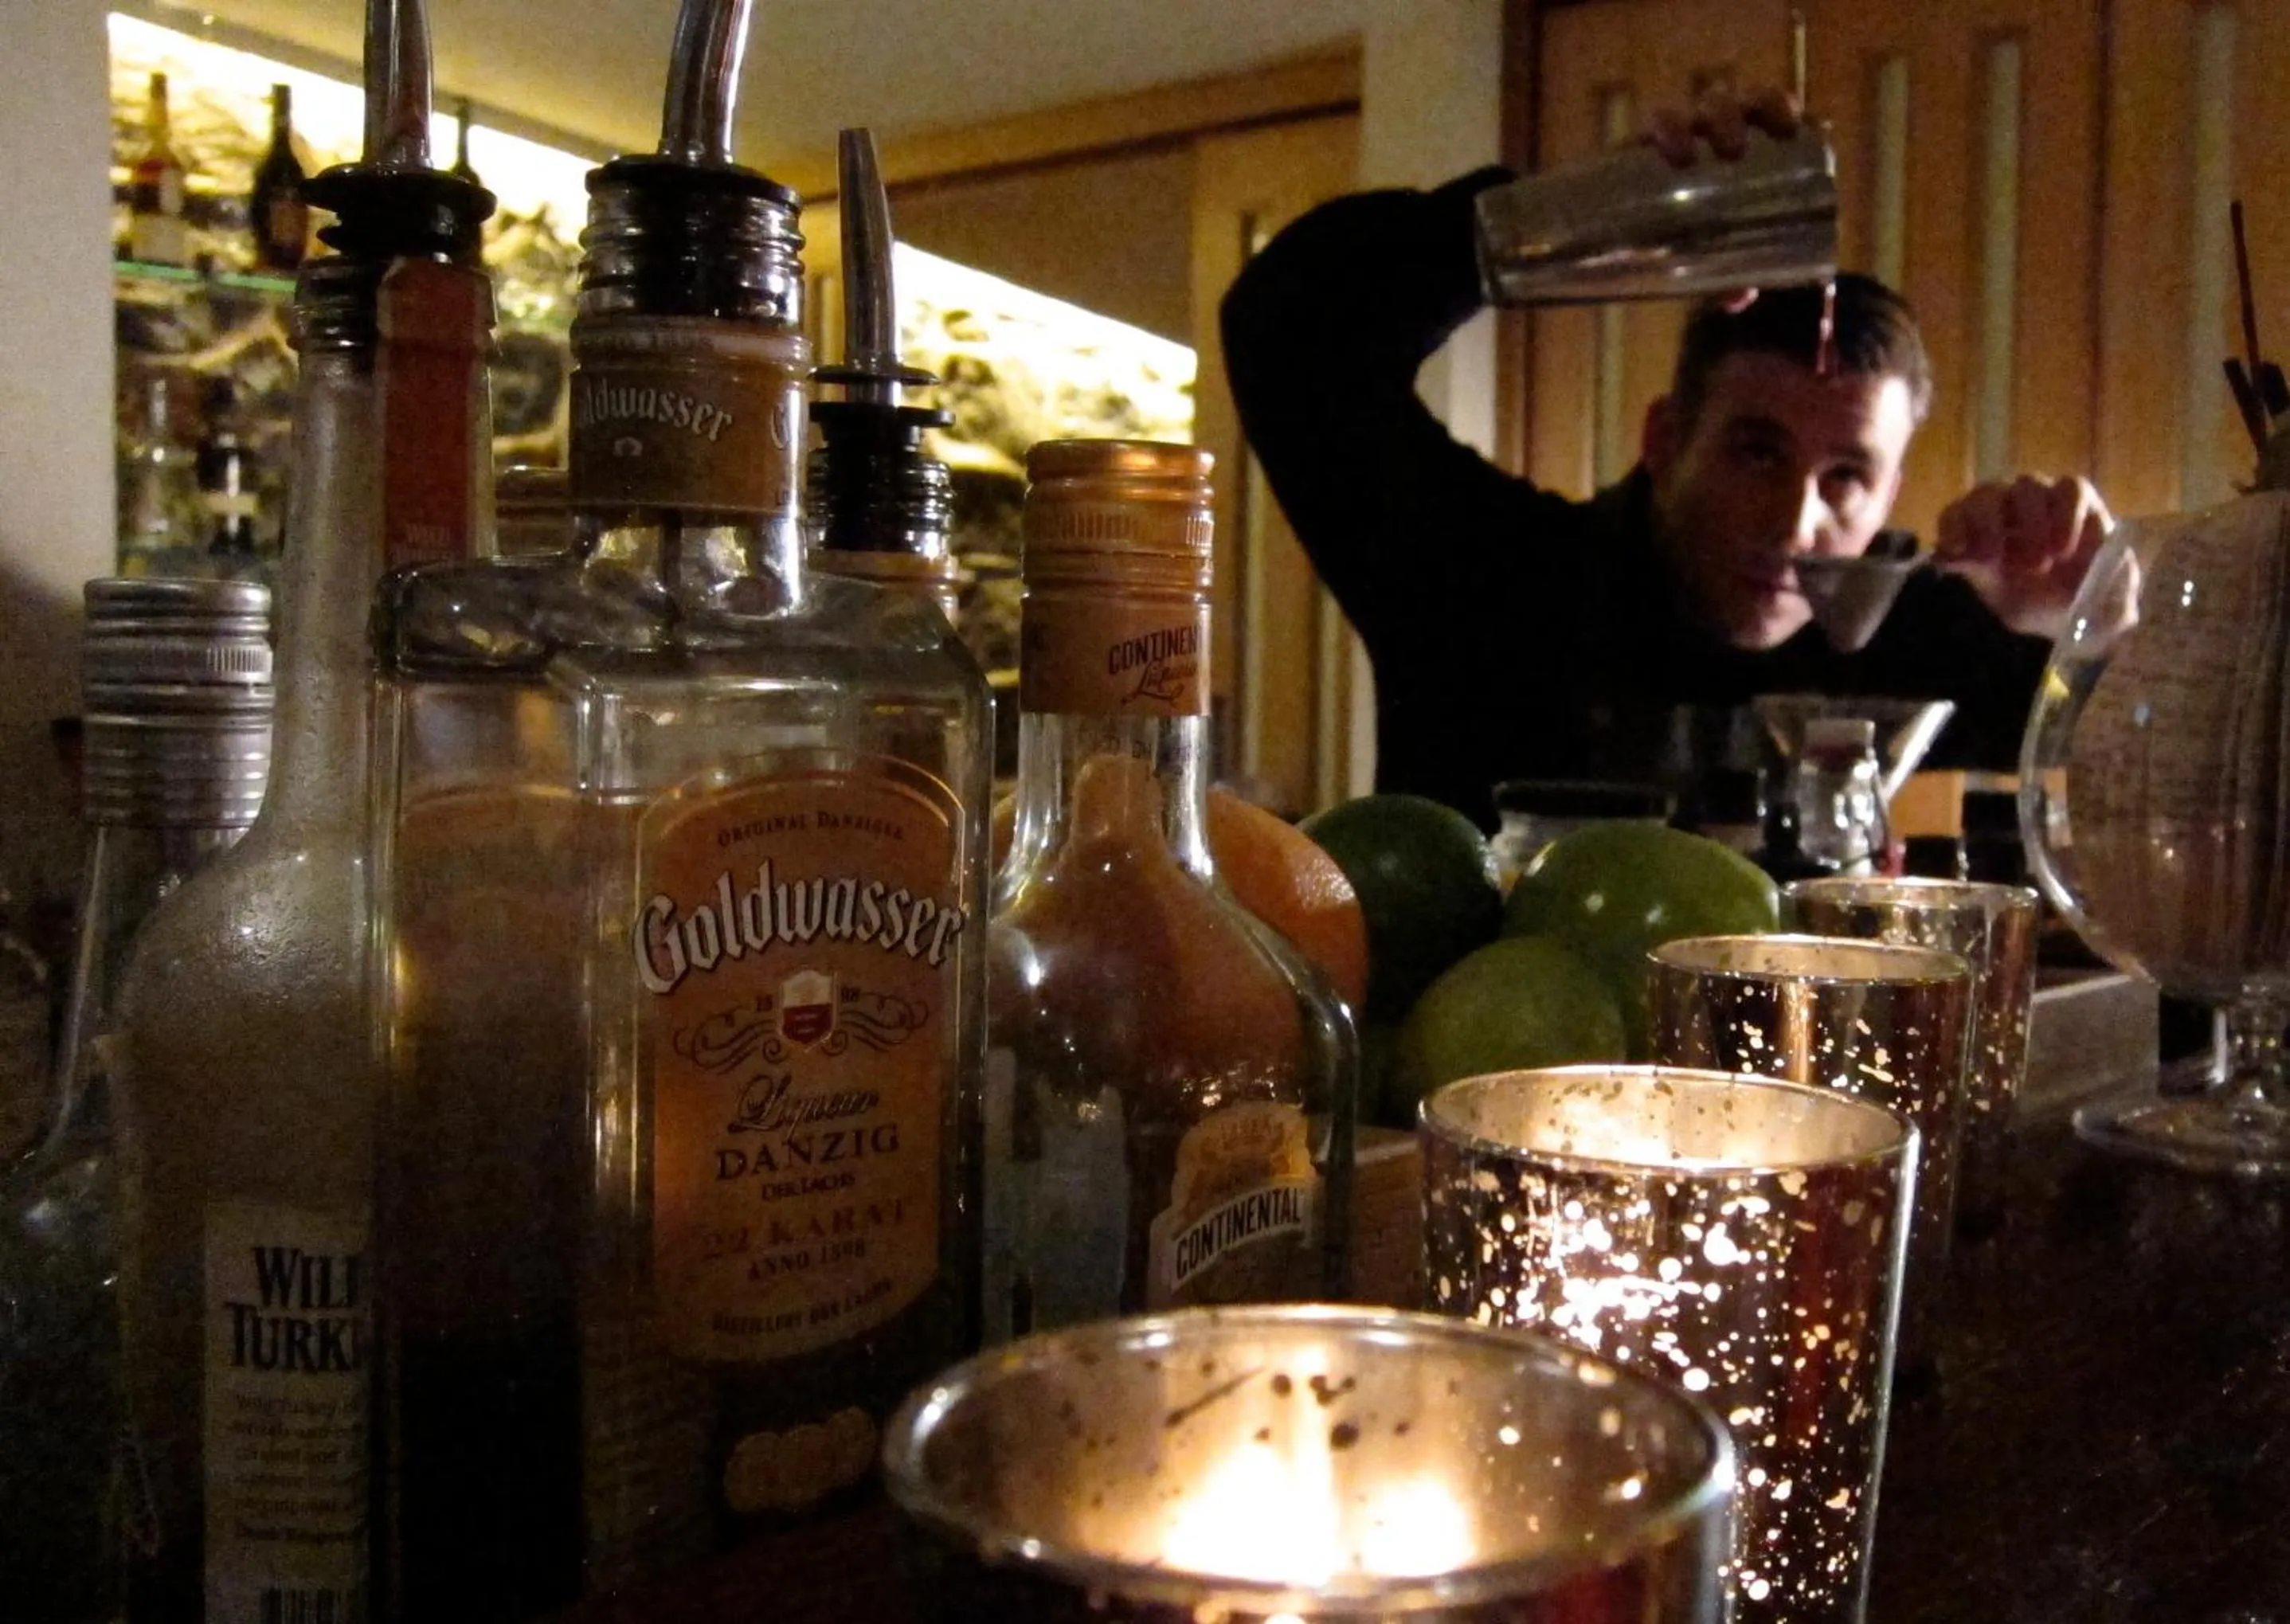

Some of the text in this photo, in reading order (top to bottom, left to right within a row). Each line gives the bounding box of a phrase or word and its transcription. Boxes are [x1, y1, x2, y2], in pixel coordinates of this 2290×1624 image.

[633, 856, 969, 996] Goldwasser
[714, 1122, 901, 1182] DANZIG
[769, 1199, 904, 1245] KARAT
[1175, 1187, 1301, 1281] CONTINENTAL
[748, 1237, 867, 1281] ANNO 1598
